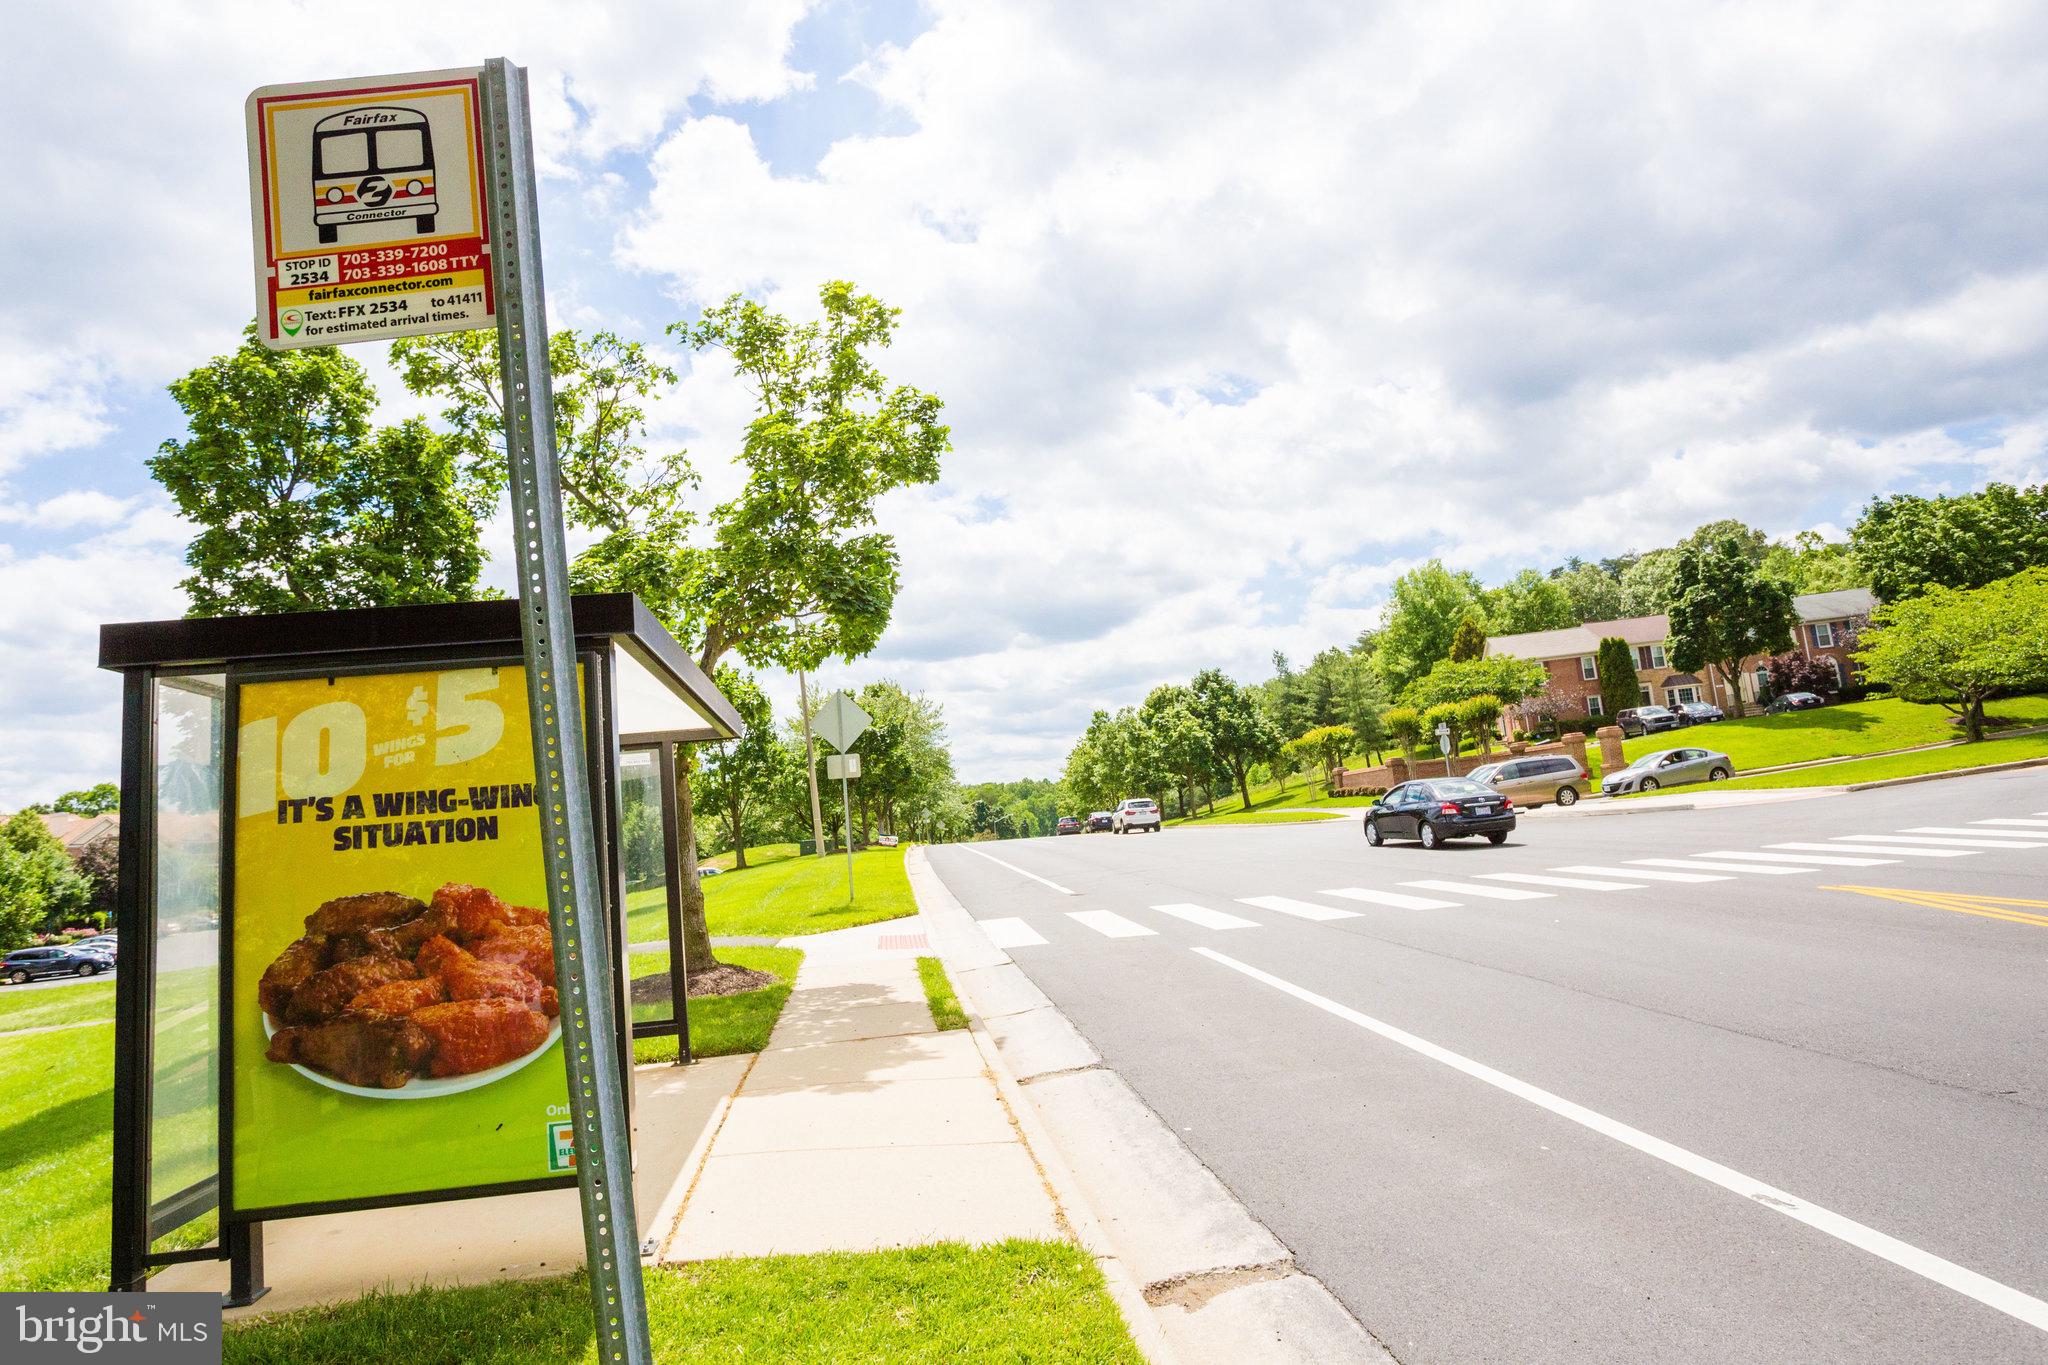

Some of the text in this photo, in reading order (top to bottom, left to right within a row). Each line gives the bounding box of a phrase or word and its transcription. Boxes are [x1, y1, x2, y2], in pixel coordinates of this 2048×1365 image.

[343, 112, 398, 126] Fairfax
[346, 208, 407, 221] Connector
[285, 258, 331, 272] STOP ID
[342, 244, 448, 266] 703-339-7200
[290, 271, 330, 286] 2534
[343, 255, 480, 281] 703-339-1608 TTY
[308, 276, 453, 301] fairfaxconnector.com
[304, 292, 483, 322] Text: FFX 2534 to 41411
[305, 310, 469, 336] for estimated arrival times.
[373, 733, 426, 757] WINGS
[238, 701, 367, 819] 10
[383, 751, 416, 769] FOR
[277, 783, 538, 825] IT'S A WING-WIN
[333, 815, 499, 851] SITUATION
